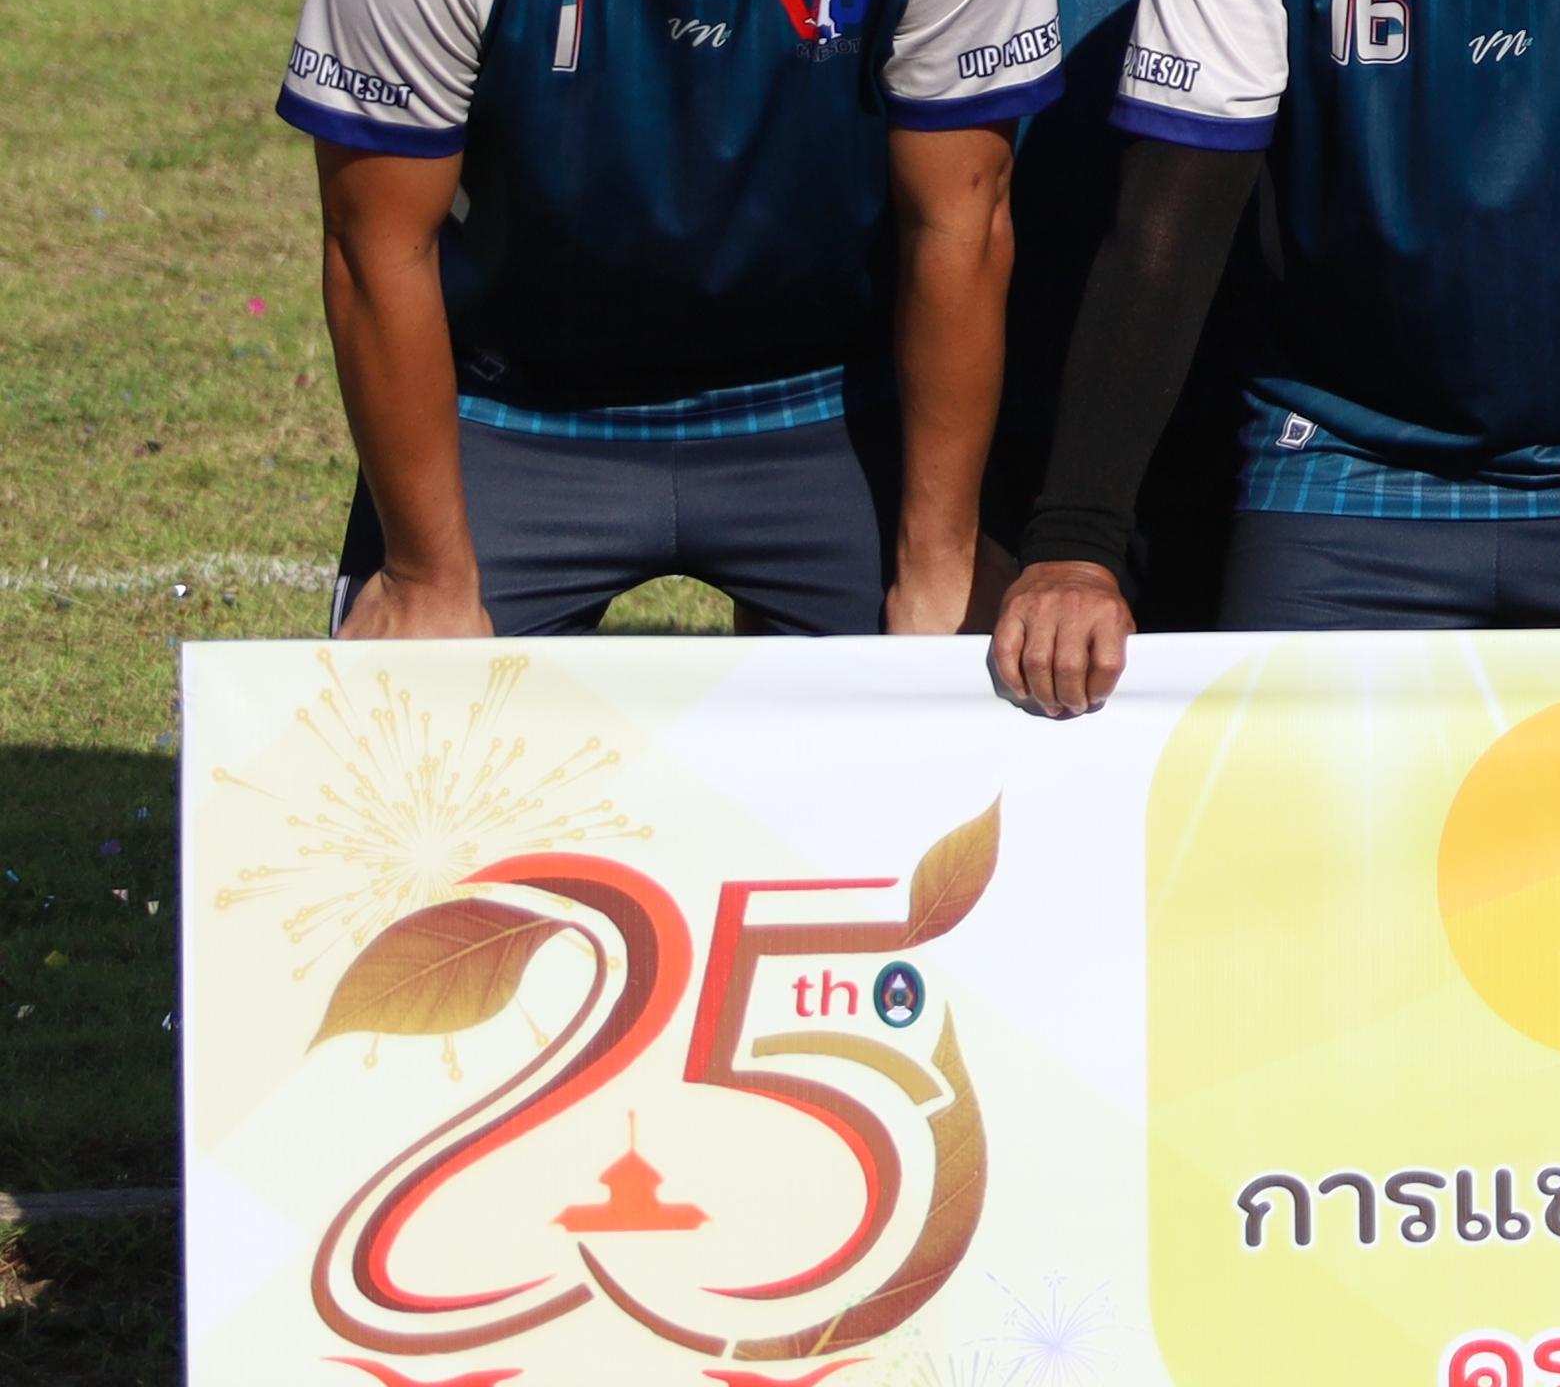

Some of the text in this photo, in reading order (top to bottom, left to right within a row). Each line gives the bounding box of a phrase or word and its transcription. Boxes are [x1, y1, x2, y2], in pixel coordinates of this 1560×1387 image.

[317, 55, 412, 107] MAESOT
[958, 45, 1001, 79] VIP
[792, 969, 860, 1018] th
